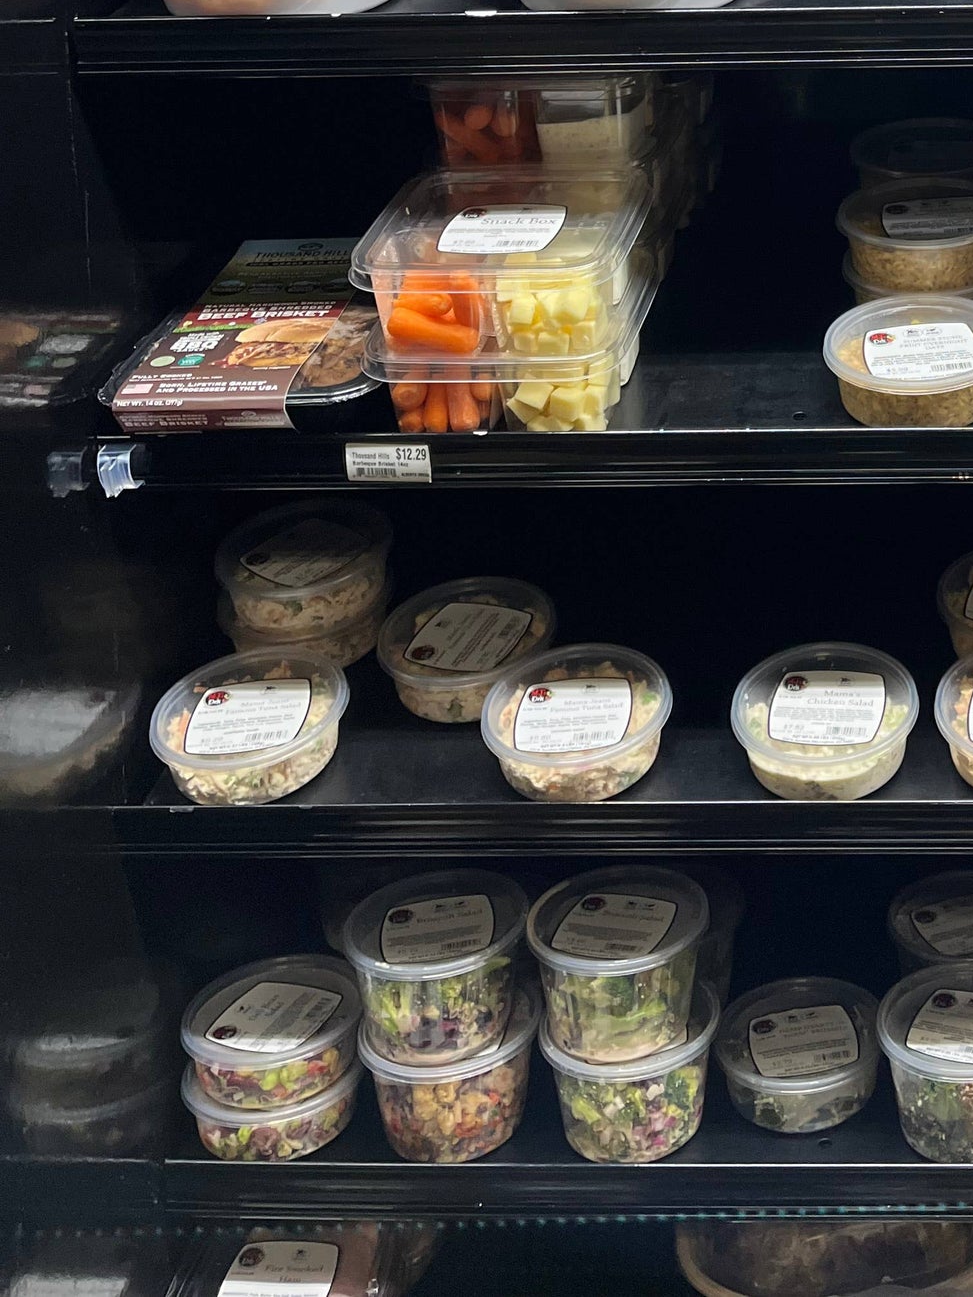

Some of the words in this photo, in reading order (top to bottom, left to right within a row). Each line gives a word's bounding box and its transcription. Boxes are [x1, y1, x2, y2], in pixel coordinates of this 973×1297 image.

[480, 217, 525, 225] Snack
[528, 217, 557, 225] Box
[197, 312, 248, 321] BEEF
[251, 310, 330, 319] BRISKET
[352, 452, 375, 460] Thousand
[378, 452, 390, 460] Hills
[395, 448, 427, 461] $12.29
[807, 698, 845, 706] Chicken
[848, 699, 874, 707] Salad
